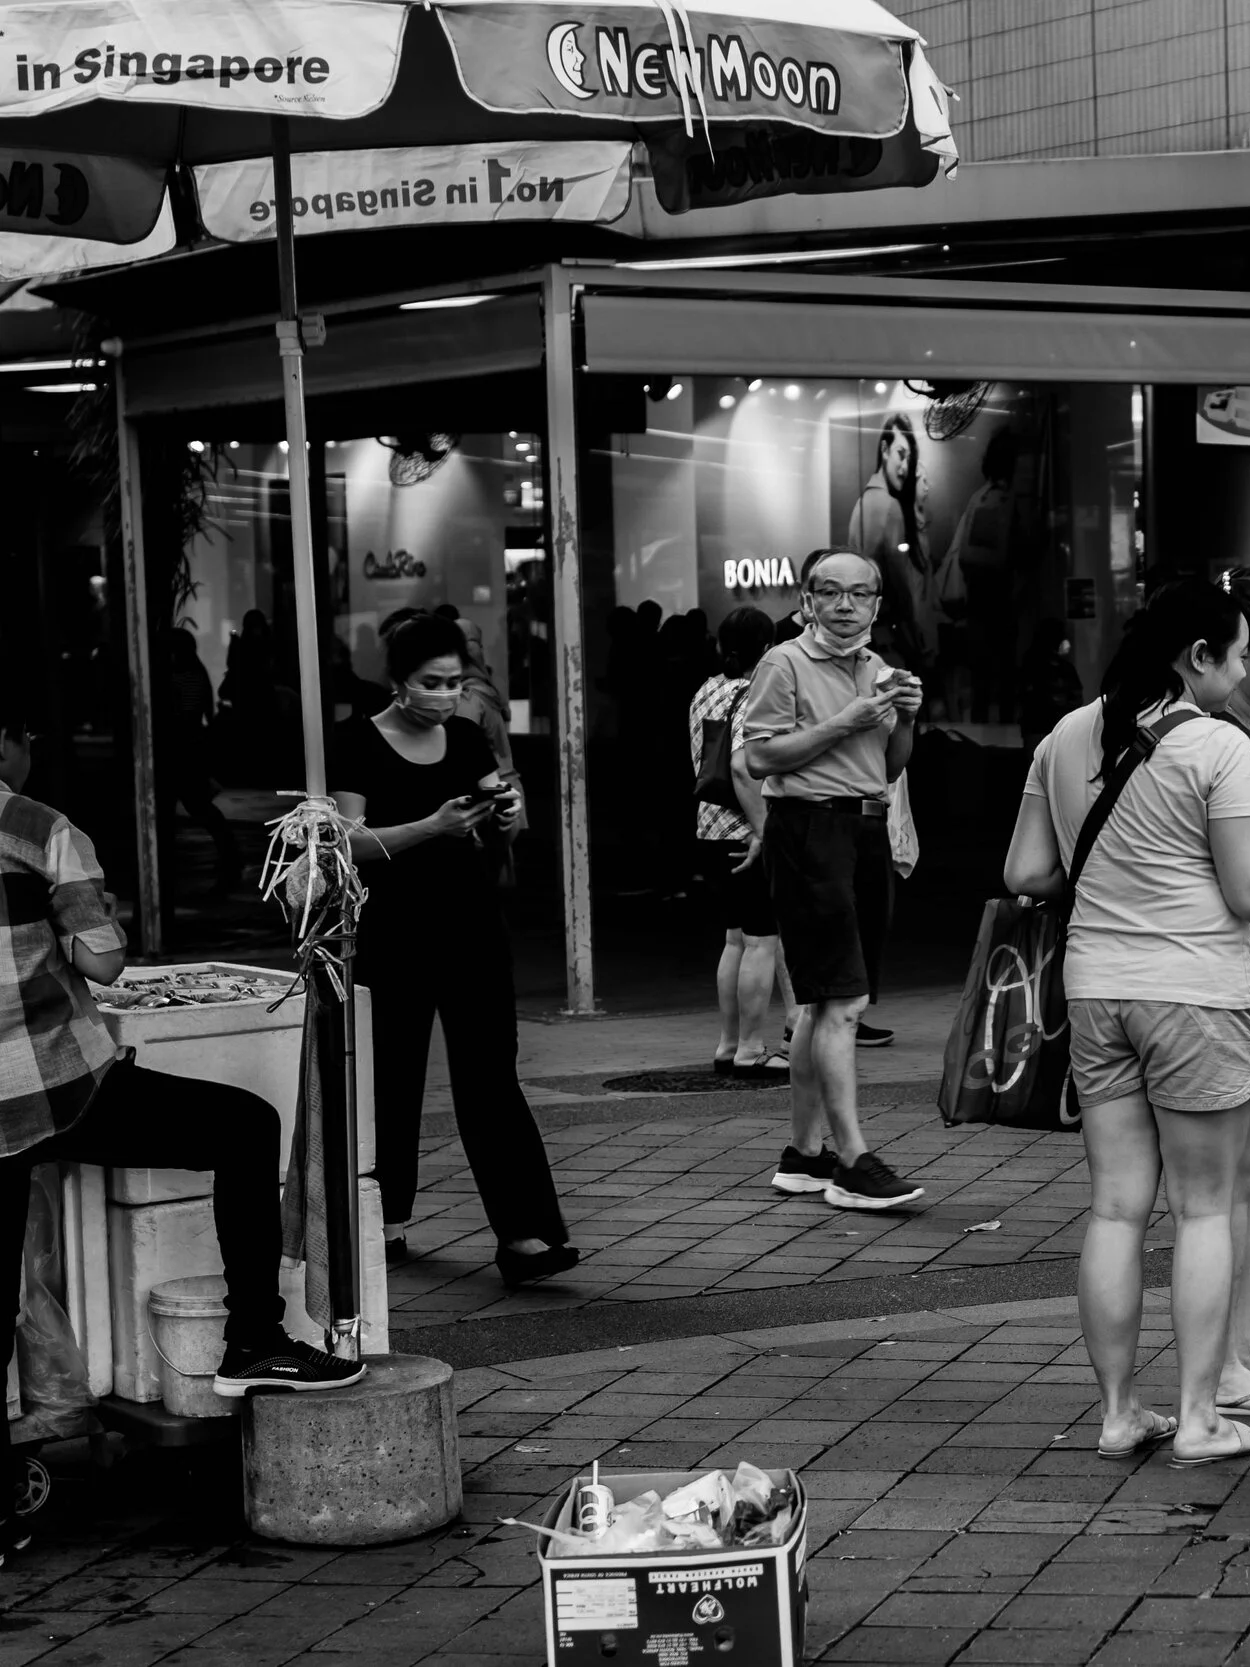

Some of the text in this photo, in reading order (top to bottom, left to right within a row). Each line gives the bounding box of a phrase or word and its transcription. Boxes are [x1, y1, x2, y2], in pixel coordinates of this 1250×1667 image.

[16, 45, 330, 91] in Singapore
[708, 34, 841, 115] Moon
[724, 557, 795, 588] BONIA
[656, 1575, 758, 1594] WOLFHEART
